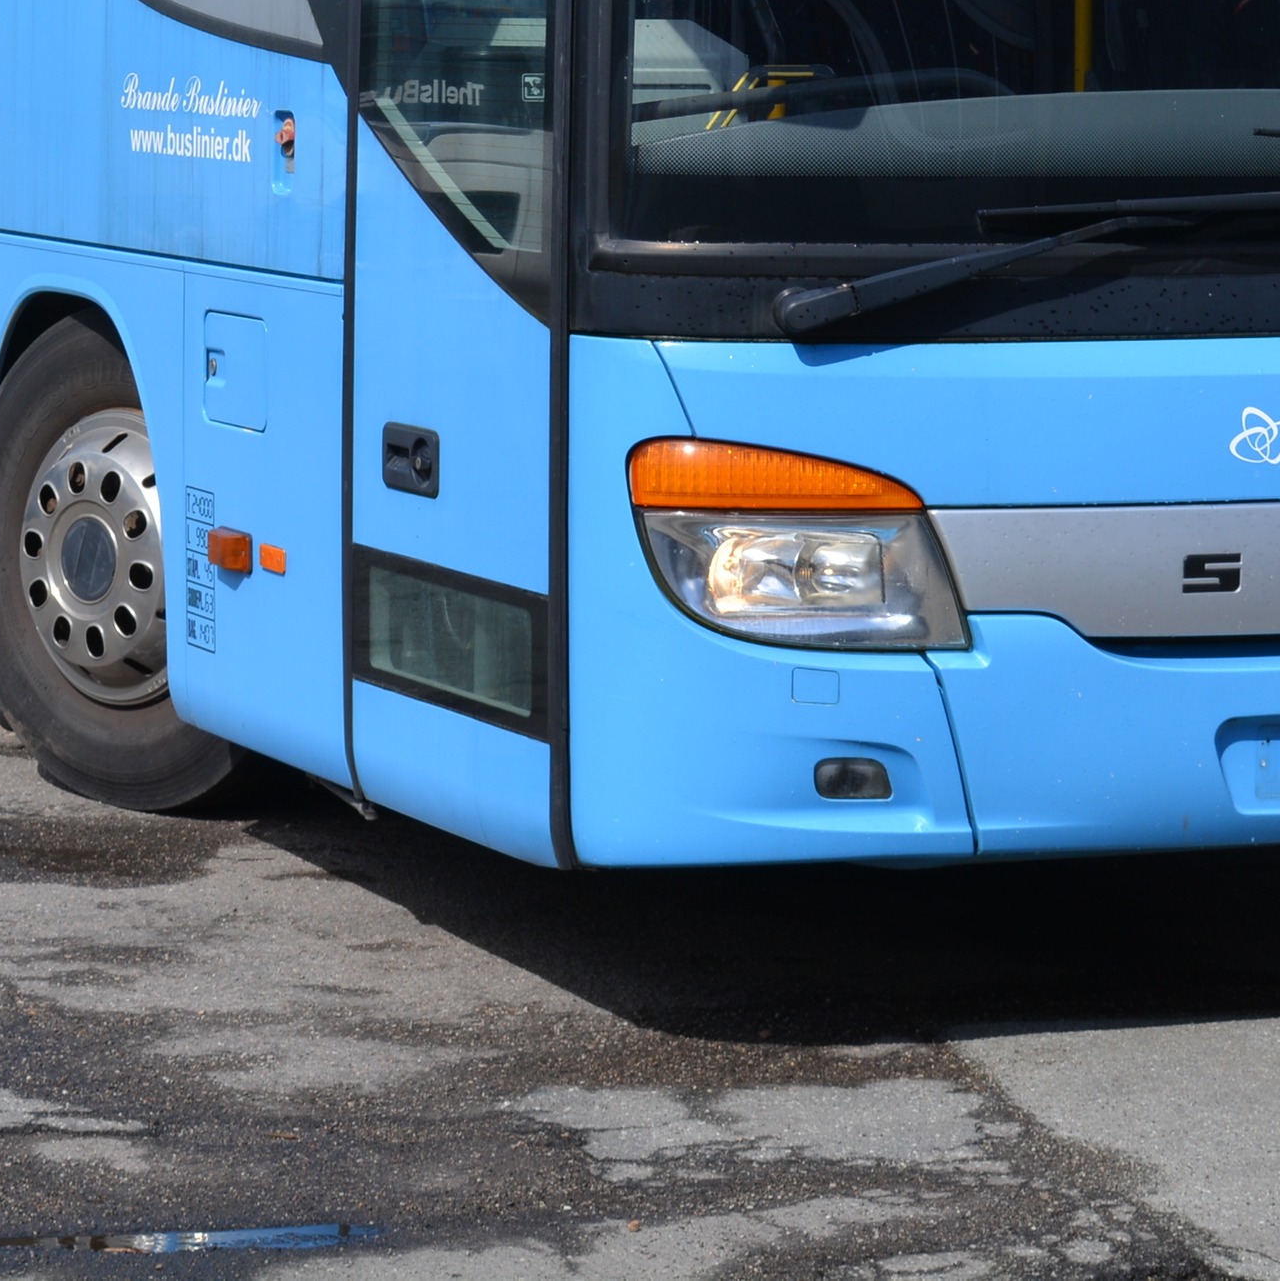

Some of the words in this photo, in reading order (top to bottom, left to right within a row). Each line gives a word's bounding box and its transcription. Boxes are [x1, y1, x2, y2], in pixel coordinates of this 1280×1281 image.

[121, 72, 181, 112] Brande
[182, 75, 262, 118] Buslinier
[130, 124, 251, 162] www.buslinier.dk
